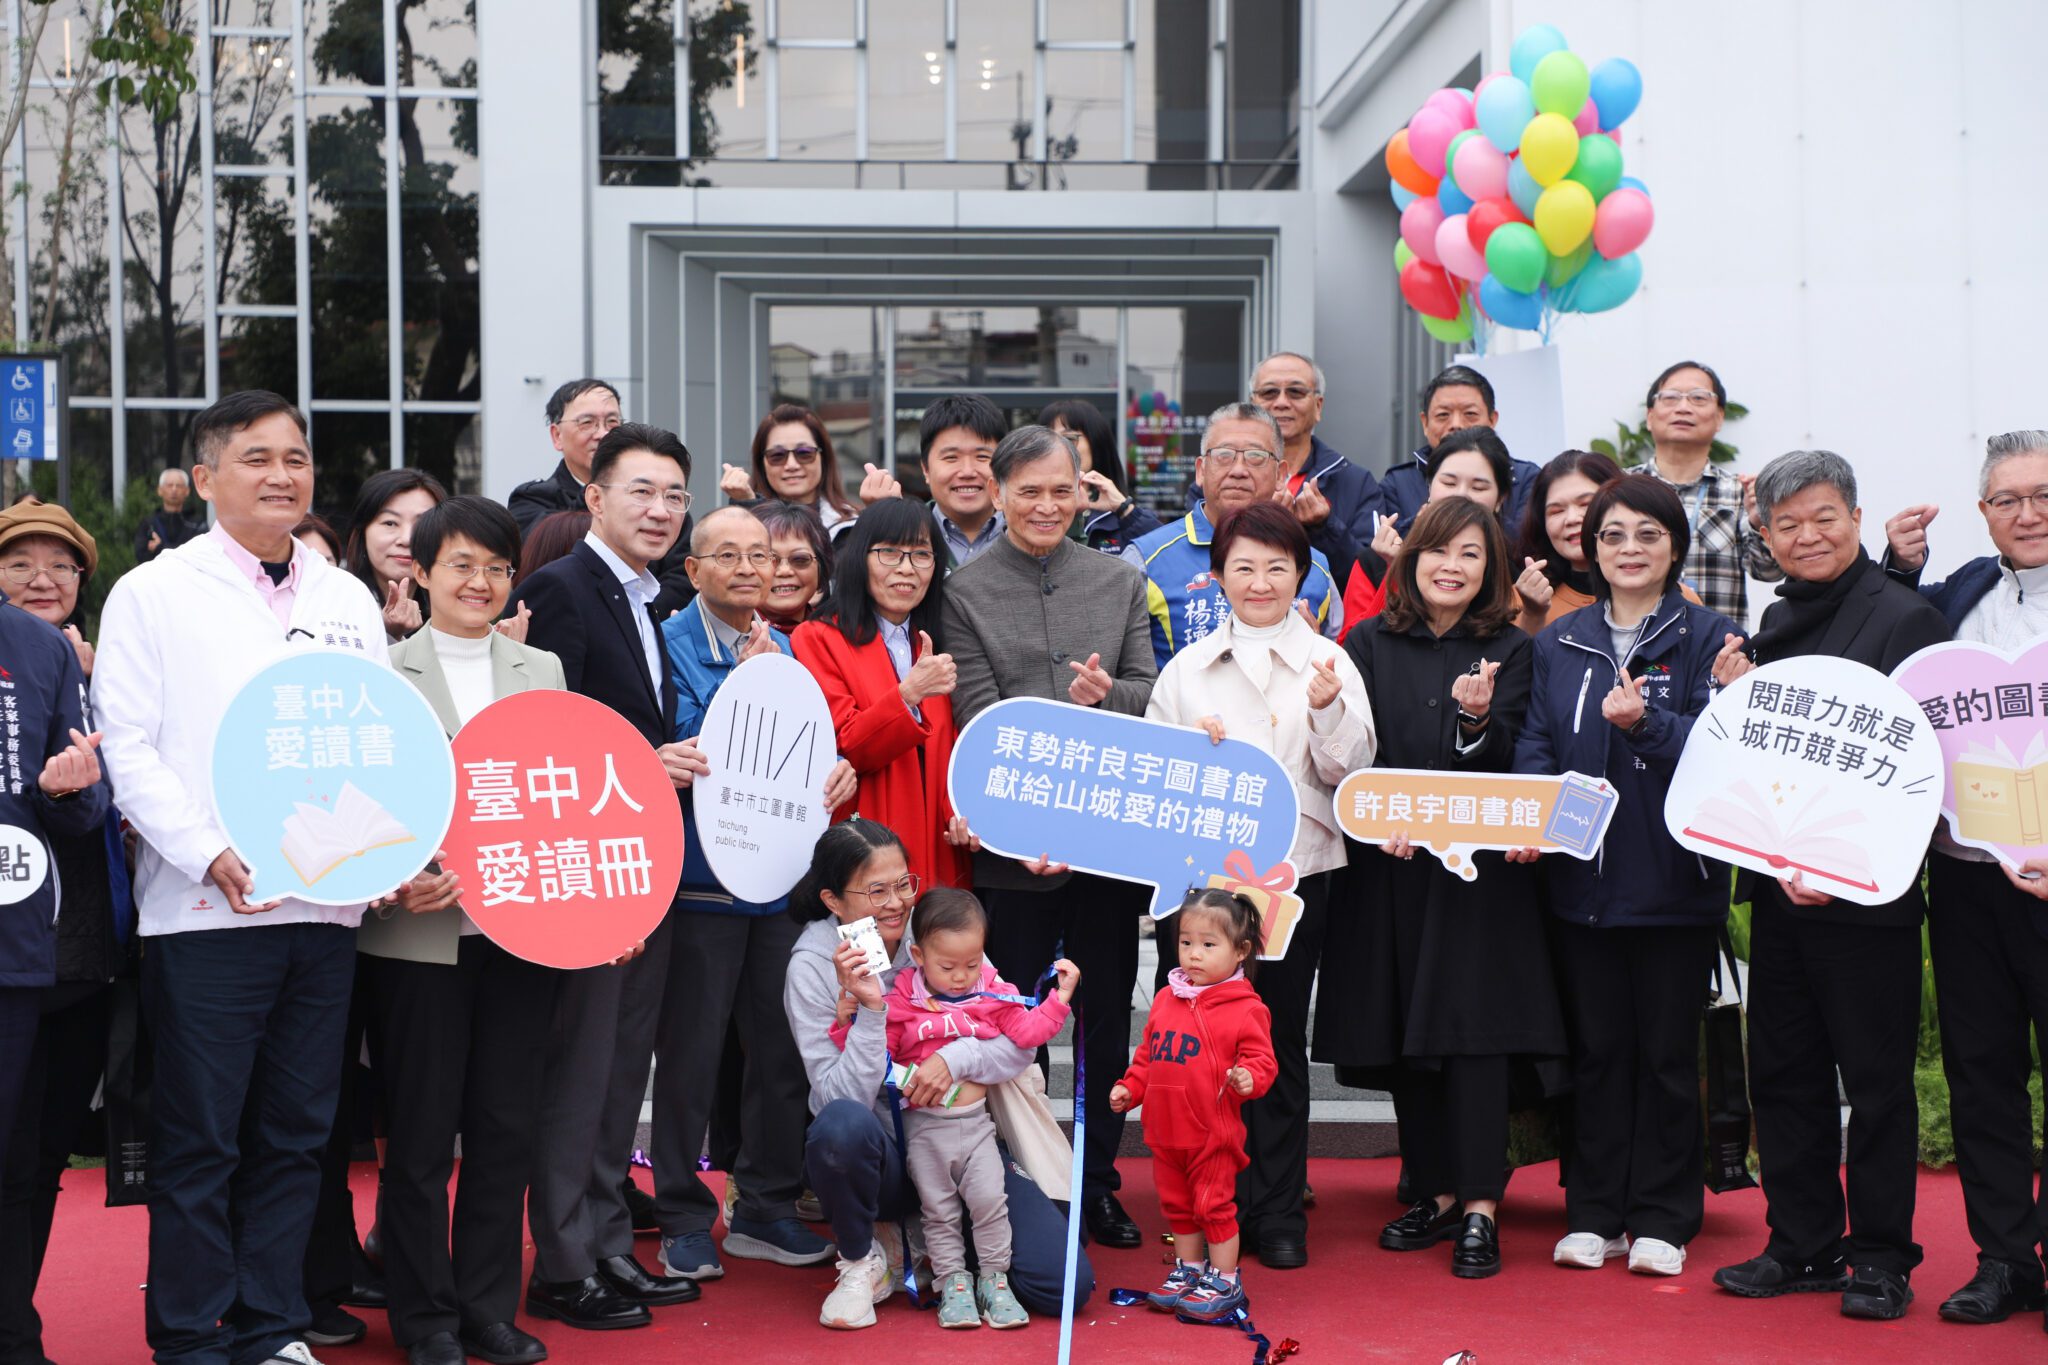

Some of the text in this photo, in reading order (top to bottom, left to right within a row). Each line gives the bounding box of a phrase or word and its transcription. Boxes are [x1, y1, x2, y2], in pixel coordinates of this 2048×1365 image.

[272, 682, 383, 723] 臺中人
[1746, 679, 1916, 753] 閱讀力就是
[1919, 682, 2048, 730] 愛的圖
[265, 724, 396, 771] 愛讀書
[992, 725, 1268, 808] 東勢許良宇圖書館
[1738, 717, 1898, 788] 城市競爭力
[462, 753, 644, 824] 臺中人
[720, 786, 807, 822] 臺中市立圖書館
[984, 764, 1260, 848] 獻給山城愛的禮物
[1354, 790, 1542, 828] 許良宇圖書館
[715, 835, 760, 854] public library
[718, 818, 748, 836] taichung
[475, 836, 653, 908] 愛讀冊
[1149, 1030, 1201, 1066] GAP
